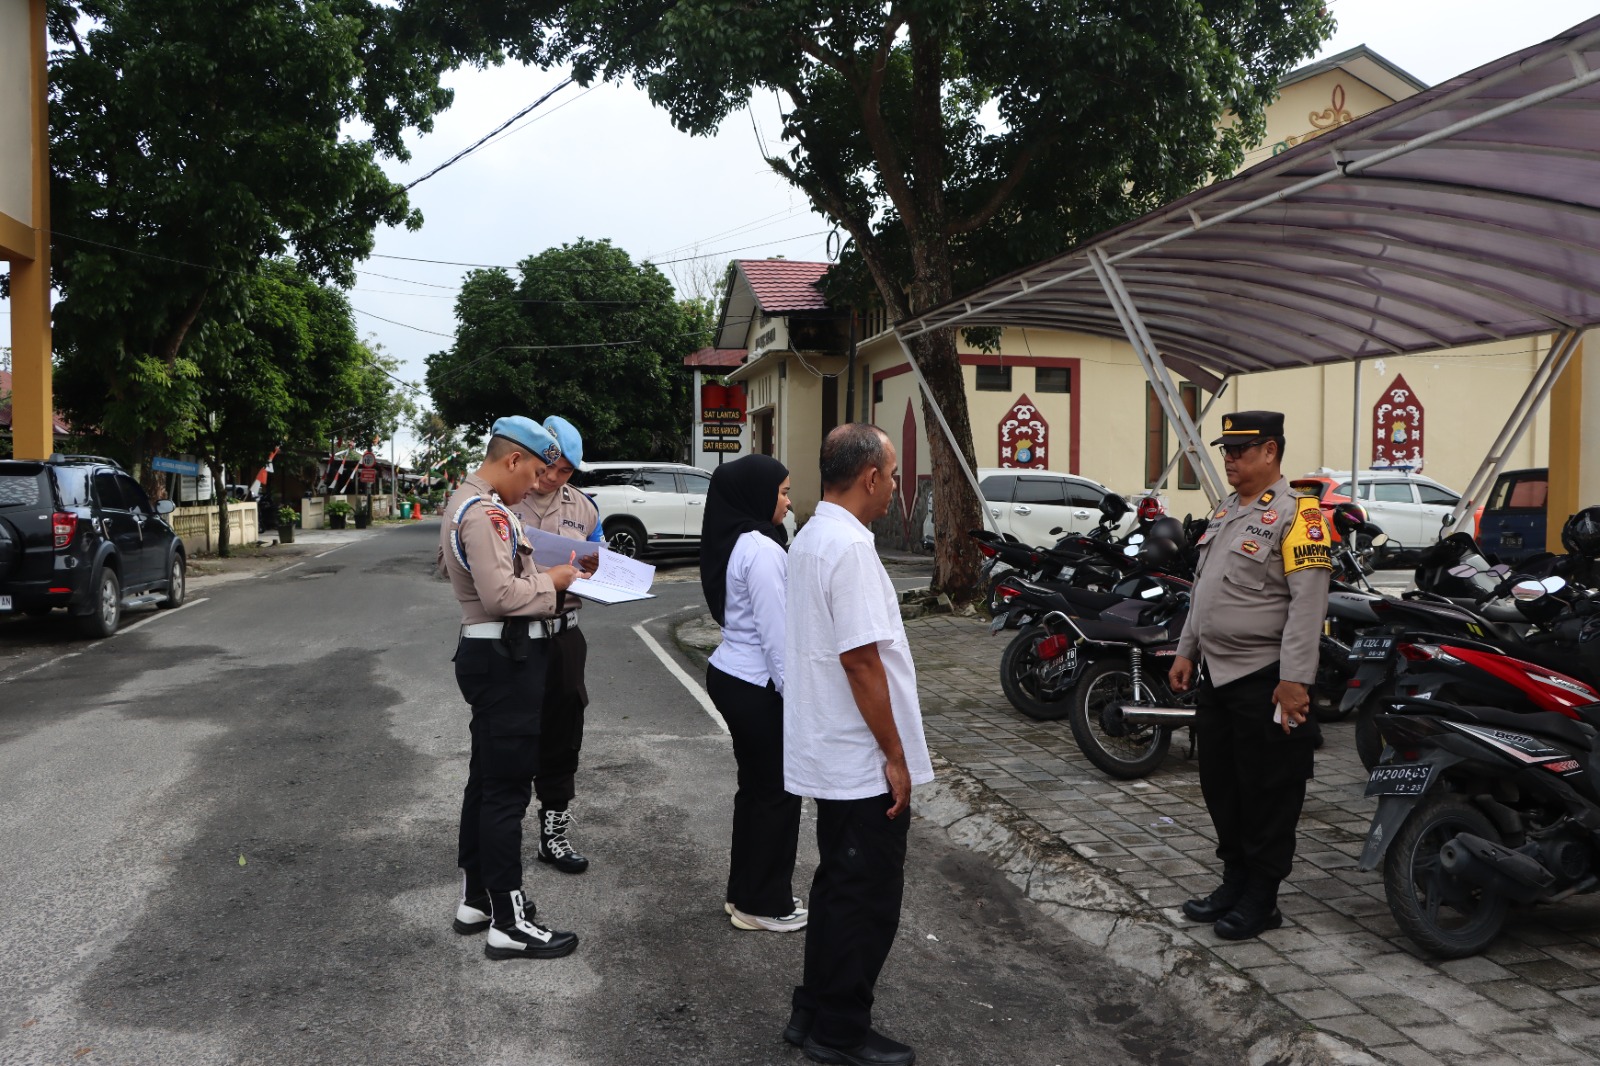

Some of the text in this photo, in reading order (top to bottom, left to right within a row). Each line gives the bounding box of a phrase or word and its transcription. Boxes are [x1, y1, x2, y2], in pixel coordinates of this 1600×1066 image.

[716, 411, 740, 419] LANTAS
[704, 426, 712, 434] SAT
[563, 519, 584, 531] POLRI
[1245, 525, 1274, 540] POLRI
